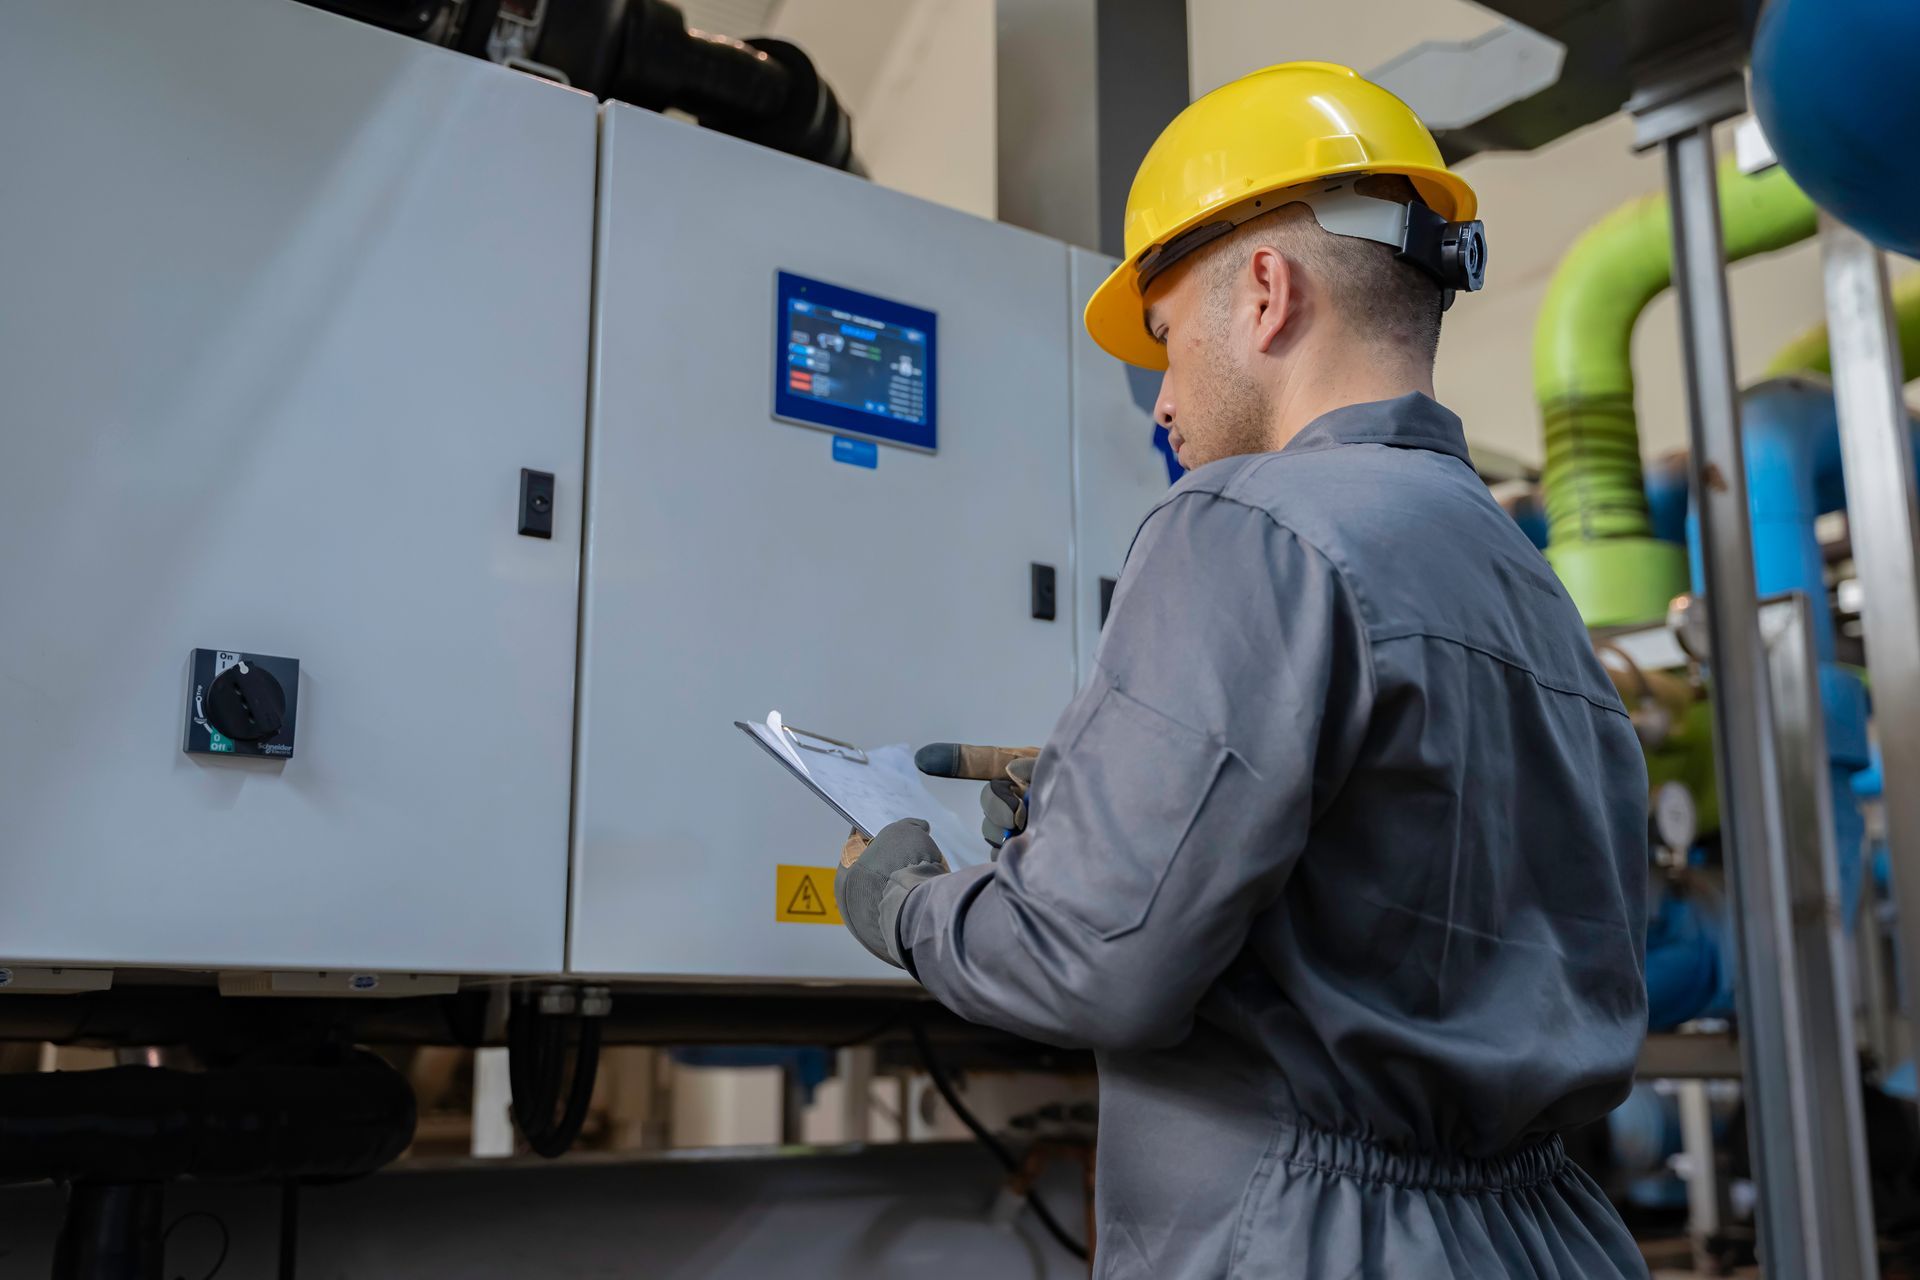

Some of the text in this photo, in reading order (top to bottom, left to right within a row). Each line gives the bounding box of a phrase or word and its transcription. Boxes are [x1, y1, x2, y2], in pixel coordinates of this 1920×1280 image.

[220, 652, 233, 660] On
[211, 742, 226, 751] Off
[257, 742, 292, 752] Schneider
